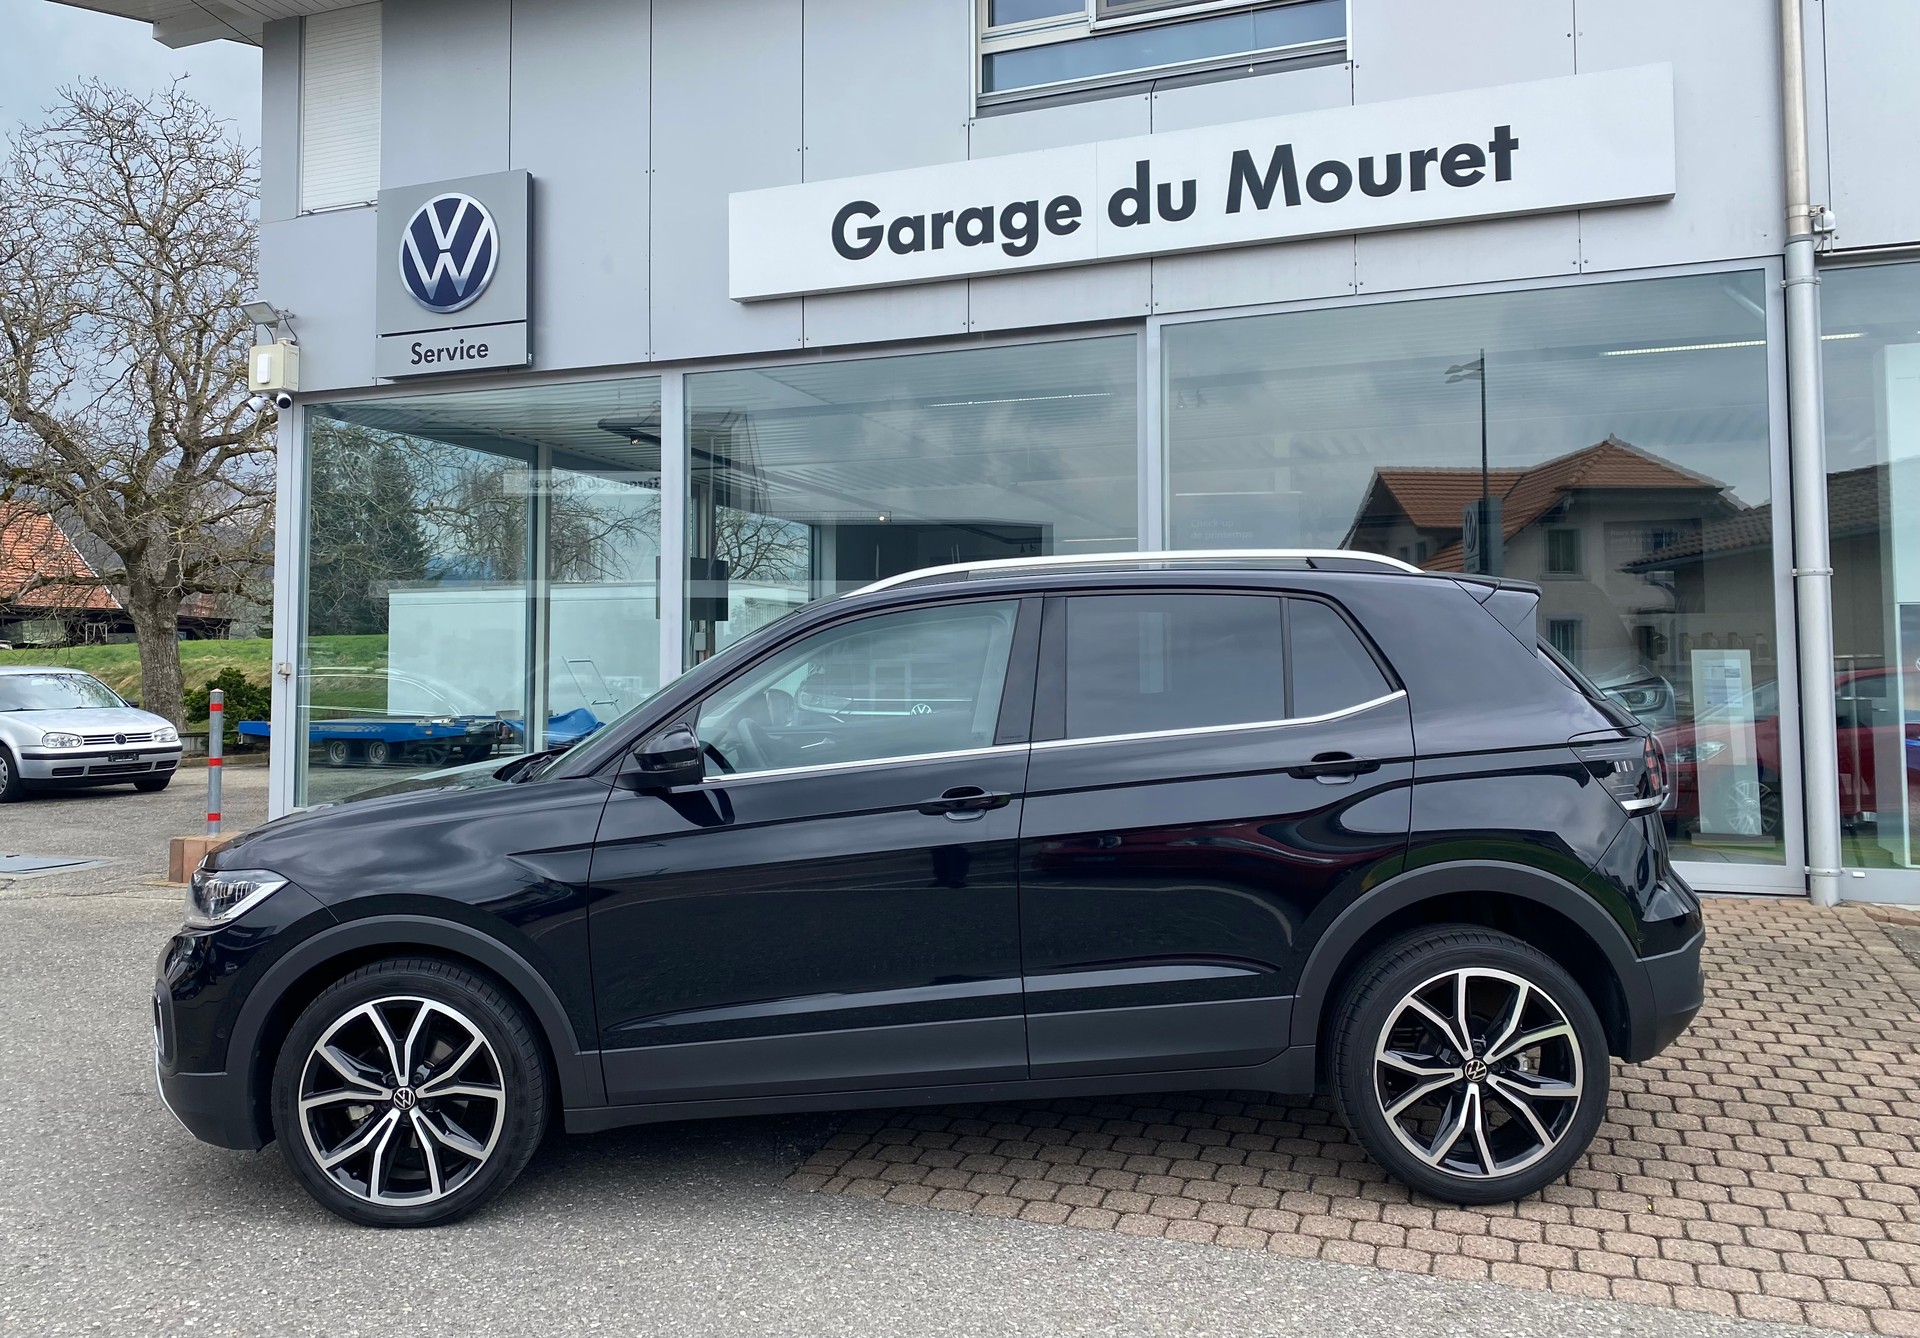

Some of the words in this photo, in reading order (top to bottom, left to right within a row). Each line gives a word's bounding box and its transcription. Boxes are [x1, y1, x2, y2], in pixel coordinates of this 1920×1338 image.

[831, 194, 1082, 261] Garage
[1107, 159, 1197, 228] du
[1225, 124, 1519, 214] Mouret
[410, 338, 489, 365] Service
